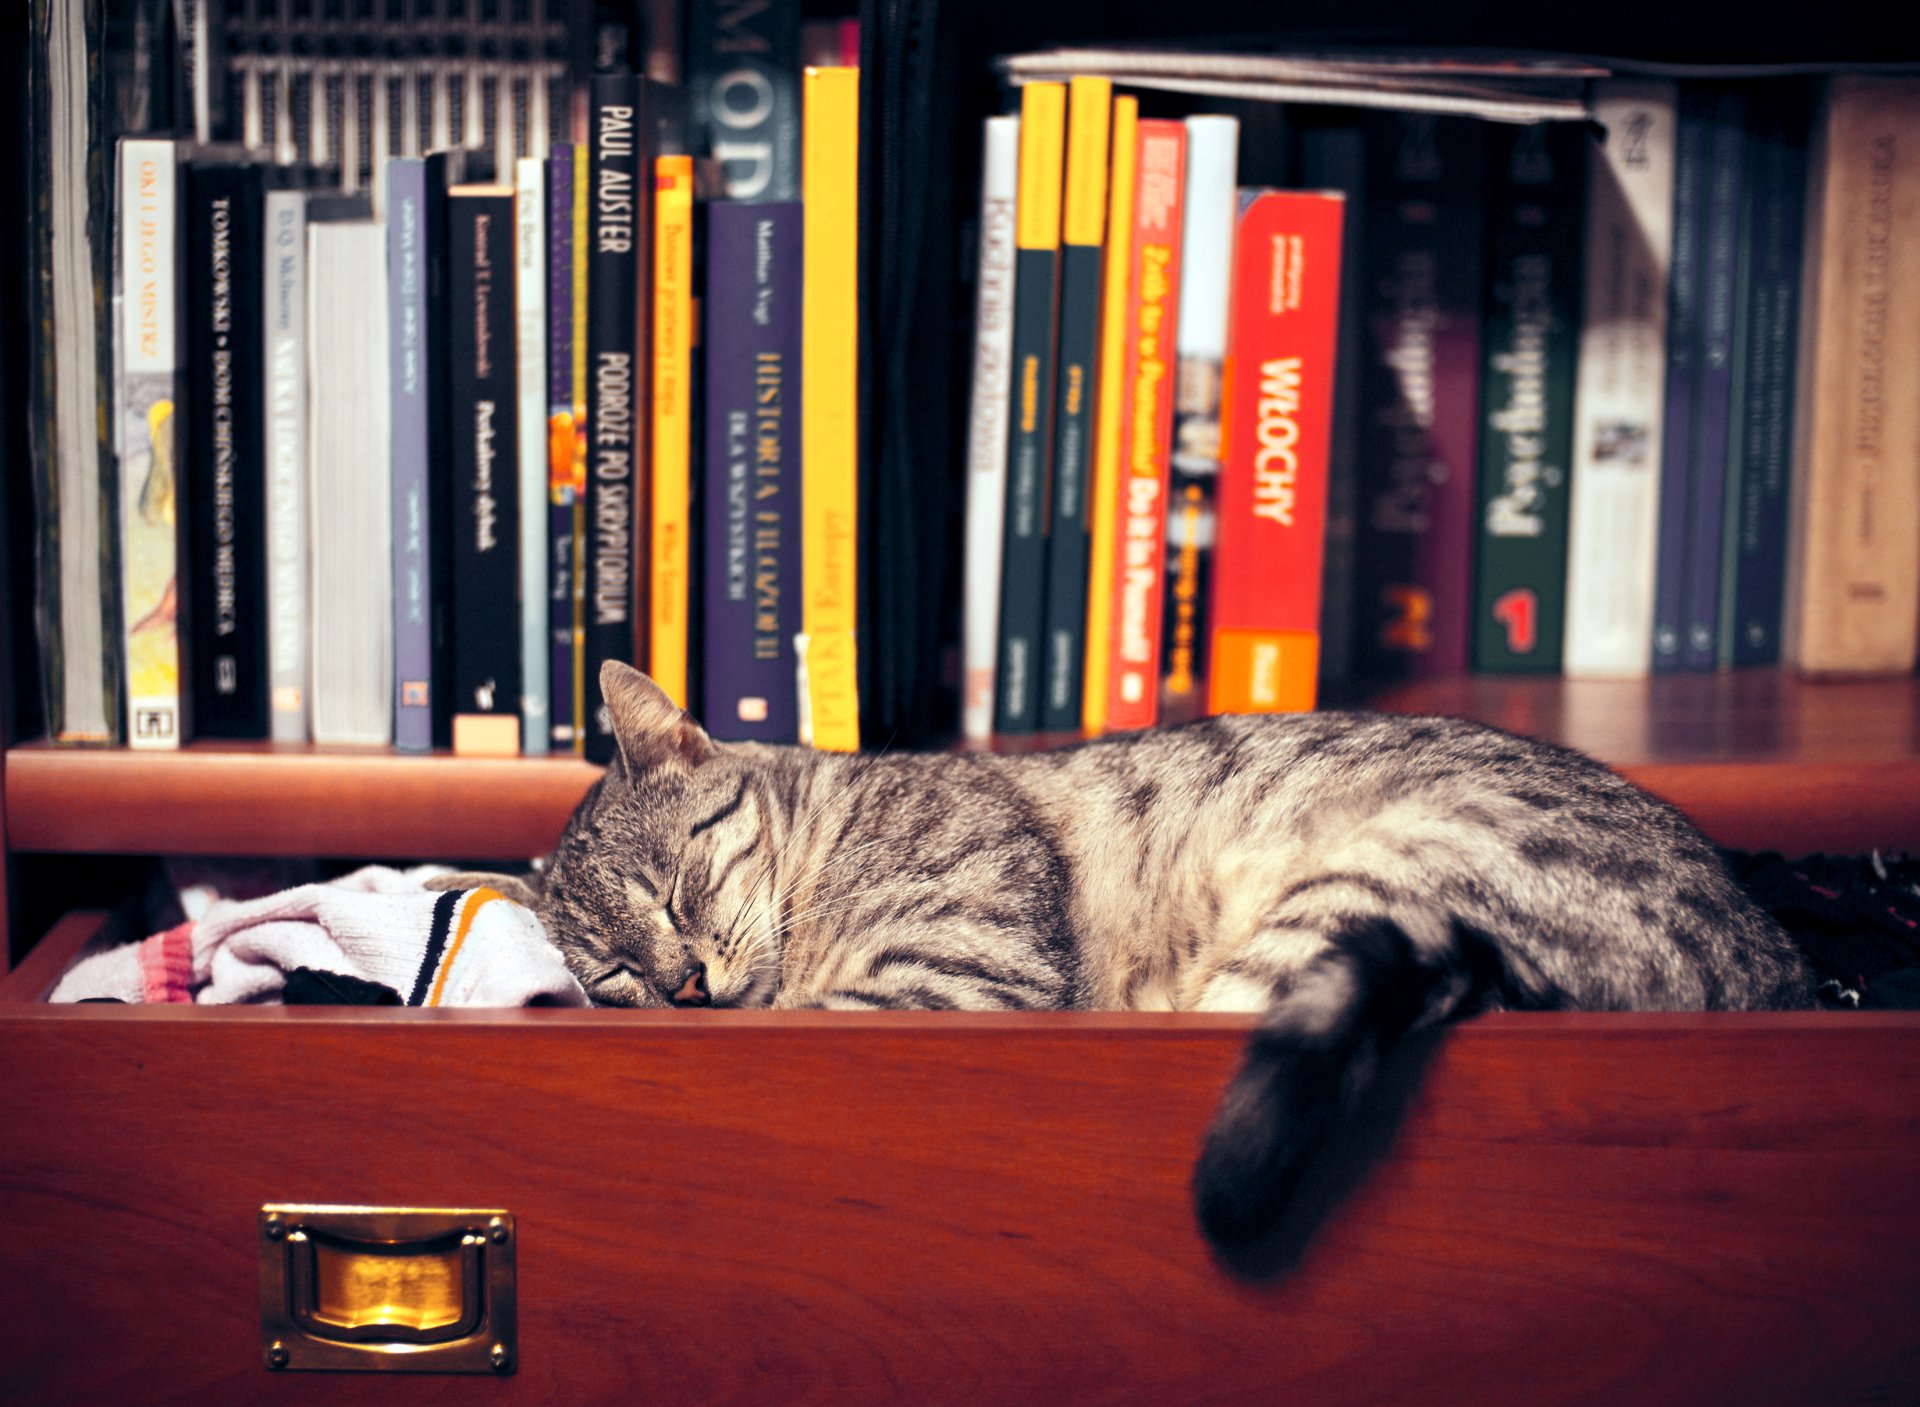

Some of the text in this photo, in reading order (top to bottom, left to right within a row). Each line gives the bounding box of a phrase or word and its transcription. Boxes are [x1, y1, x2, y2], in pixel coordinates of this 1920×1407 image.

[599, 106, 634, 254] PAUL AUSTER
[140, 218, 158, 274] JEGO
[212, 198, 233, 332] TOMKOWSKI
[756, 221, 775, 285] Matthias
[598, 449, 629, 480] PO
[1253, 357, 1302, 526] WŁOCHY
[728, 411, 748, 600] DLA WSZYSTKICH
[755, 352, 782, 659] HISTORIA FILOZOFII
[1129, 477, 1158, 514] Do
[596, 483, 630, 625] SKRYPTORIUM
[1127, 538, 1155, 565] in
[1492, 590, 1536, 652] 1
[814, 624, 848, 730] PTAKI
